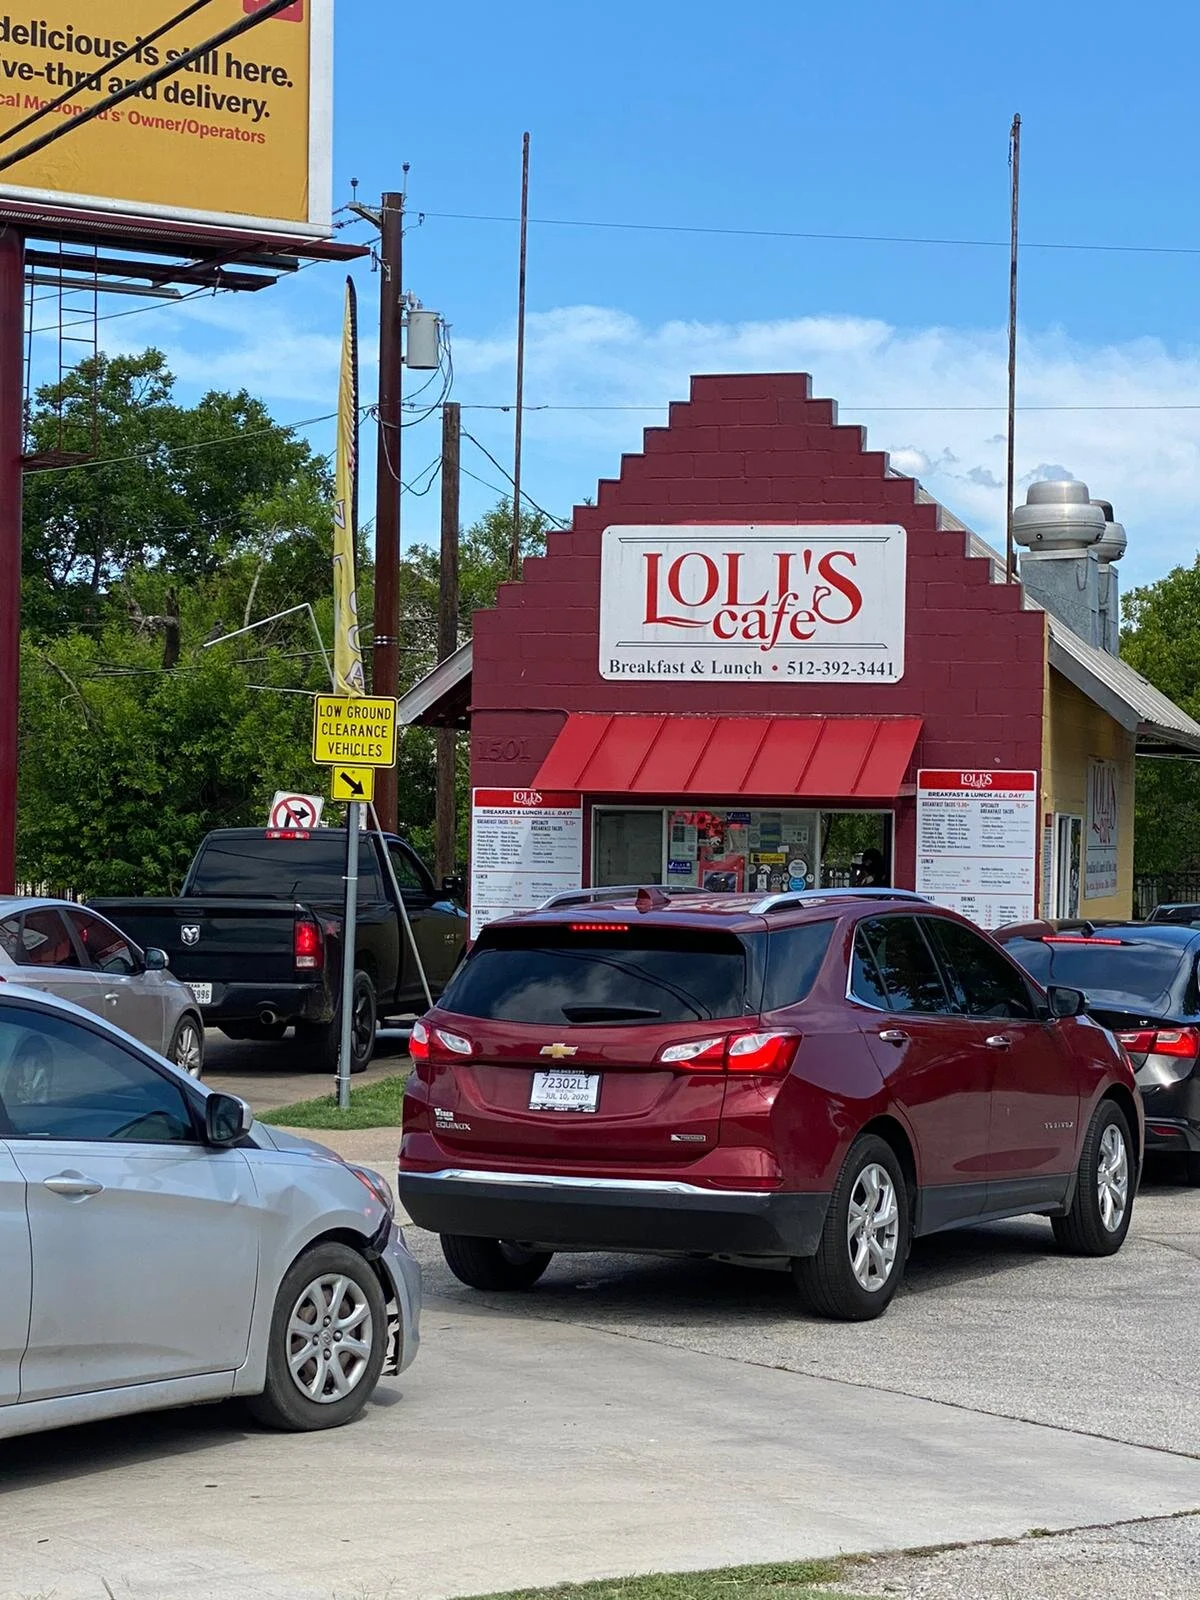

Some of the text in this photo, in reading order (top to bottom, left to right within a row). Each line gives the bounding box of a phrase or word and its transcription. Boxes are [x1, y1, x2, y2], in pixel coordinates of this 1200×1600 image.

[0, 16, 127, 60] delicious
[135, 36, 159, 66] is
[226, 52, 293, 88] here.
[0, 58, 101, 92] ve-thru
[164, 81, 270, 123] delivery.
[128, 110, 266, 144] Owner/Operators
[642, 549, 863, 628] LOLI'S
[712, 592, 817, 651] cafe
[609, 659, 894, 677] Breakfast & Lunch 512-392-3441
[320, 705, 391, 720] LOW GROUND
[321, 722, 388, 739] CLEARANCE
[328, 742, 382, 757] VEHICLES
[960, 773, 993, 785] LOLI'S
[541, 1077, 590, 1090] 72302L1
[545, 1092, 557, 1100] JUL
[559, 1093, 570, 1101] 10,
